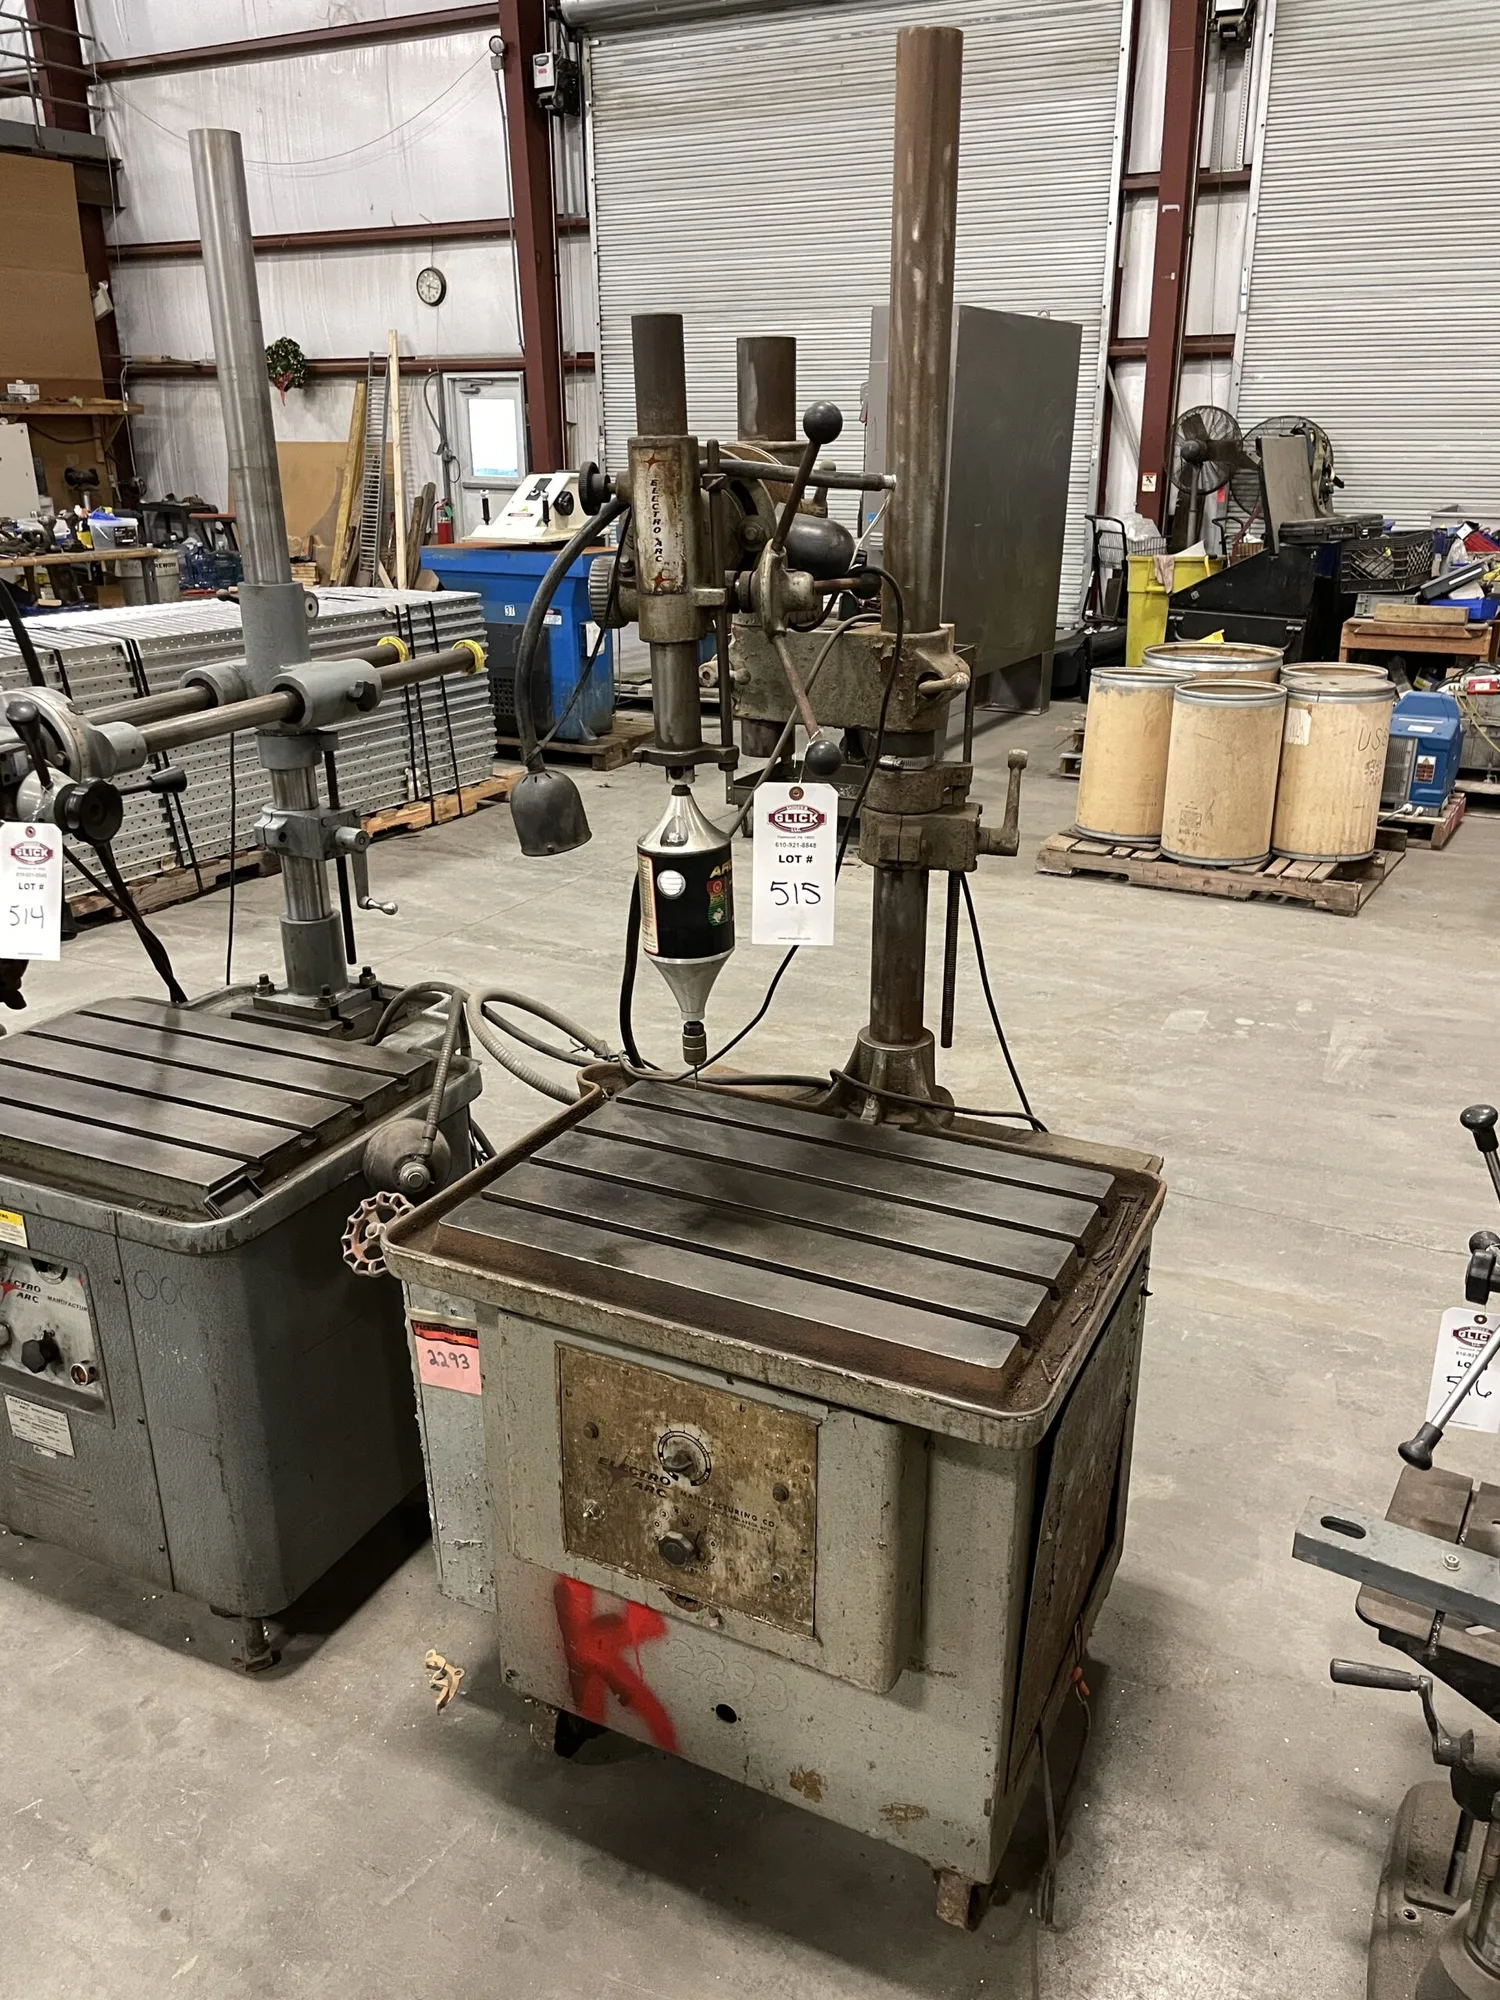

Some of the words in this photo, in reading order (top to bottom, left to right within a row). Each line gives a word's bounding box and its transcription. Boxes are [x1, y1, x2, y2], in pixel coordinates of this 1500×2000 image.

[650, 479, 662, 534] ELECTRO
[653, 537, 664, 563] ARC
[774, 813, 819, 824] GLICK
[14, 848, 49, 858] GLICK
[778, 854, 802, 864] LOT
[805, 854, 814, 864] #
[18, 882, 37, 890] LOT
[770, 880, 822, 906] 515
[9, 904, 45, 929] 514
[16, 1292, 40, 1304] ARC
[1458, 1330, 1488, 1342] GLIC
[427, 1349, 470, 1370] 2293
[1457, 1360, 1472, 1369] LO
[597, 1456, 671, 1487] ELECTRO
[631, 1481, 668, 1499] ARC
